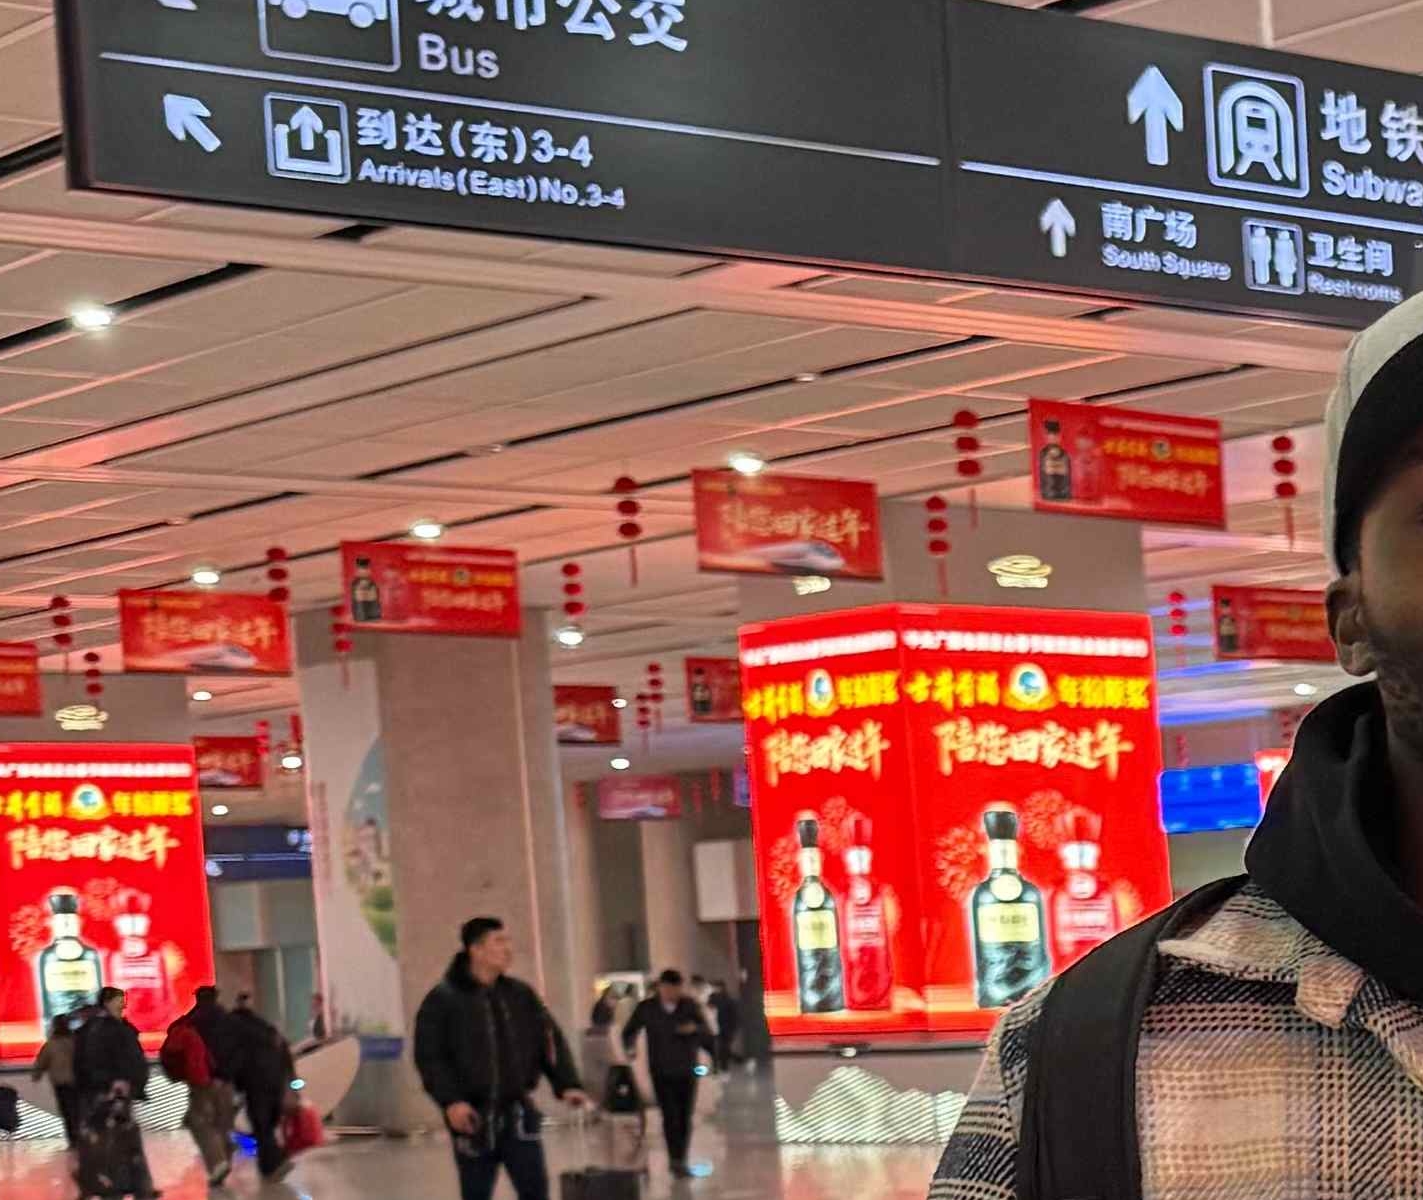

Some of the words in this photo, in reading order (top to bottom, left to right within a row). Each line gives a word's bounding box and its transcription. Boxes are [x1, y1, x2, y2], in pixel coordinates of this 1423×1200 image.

[418, 32, 500, 79] Bus
[356, 106, 594, 168] 到达(东)3-4
[1100, 200, 1197, 249] 南广场
[1101, 244, 1161, 274] South
[1161, 252, 1232, 281] Square
[1306, 231, 1394, 277] 卫生间
